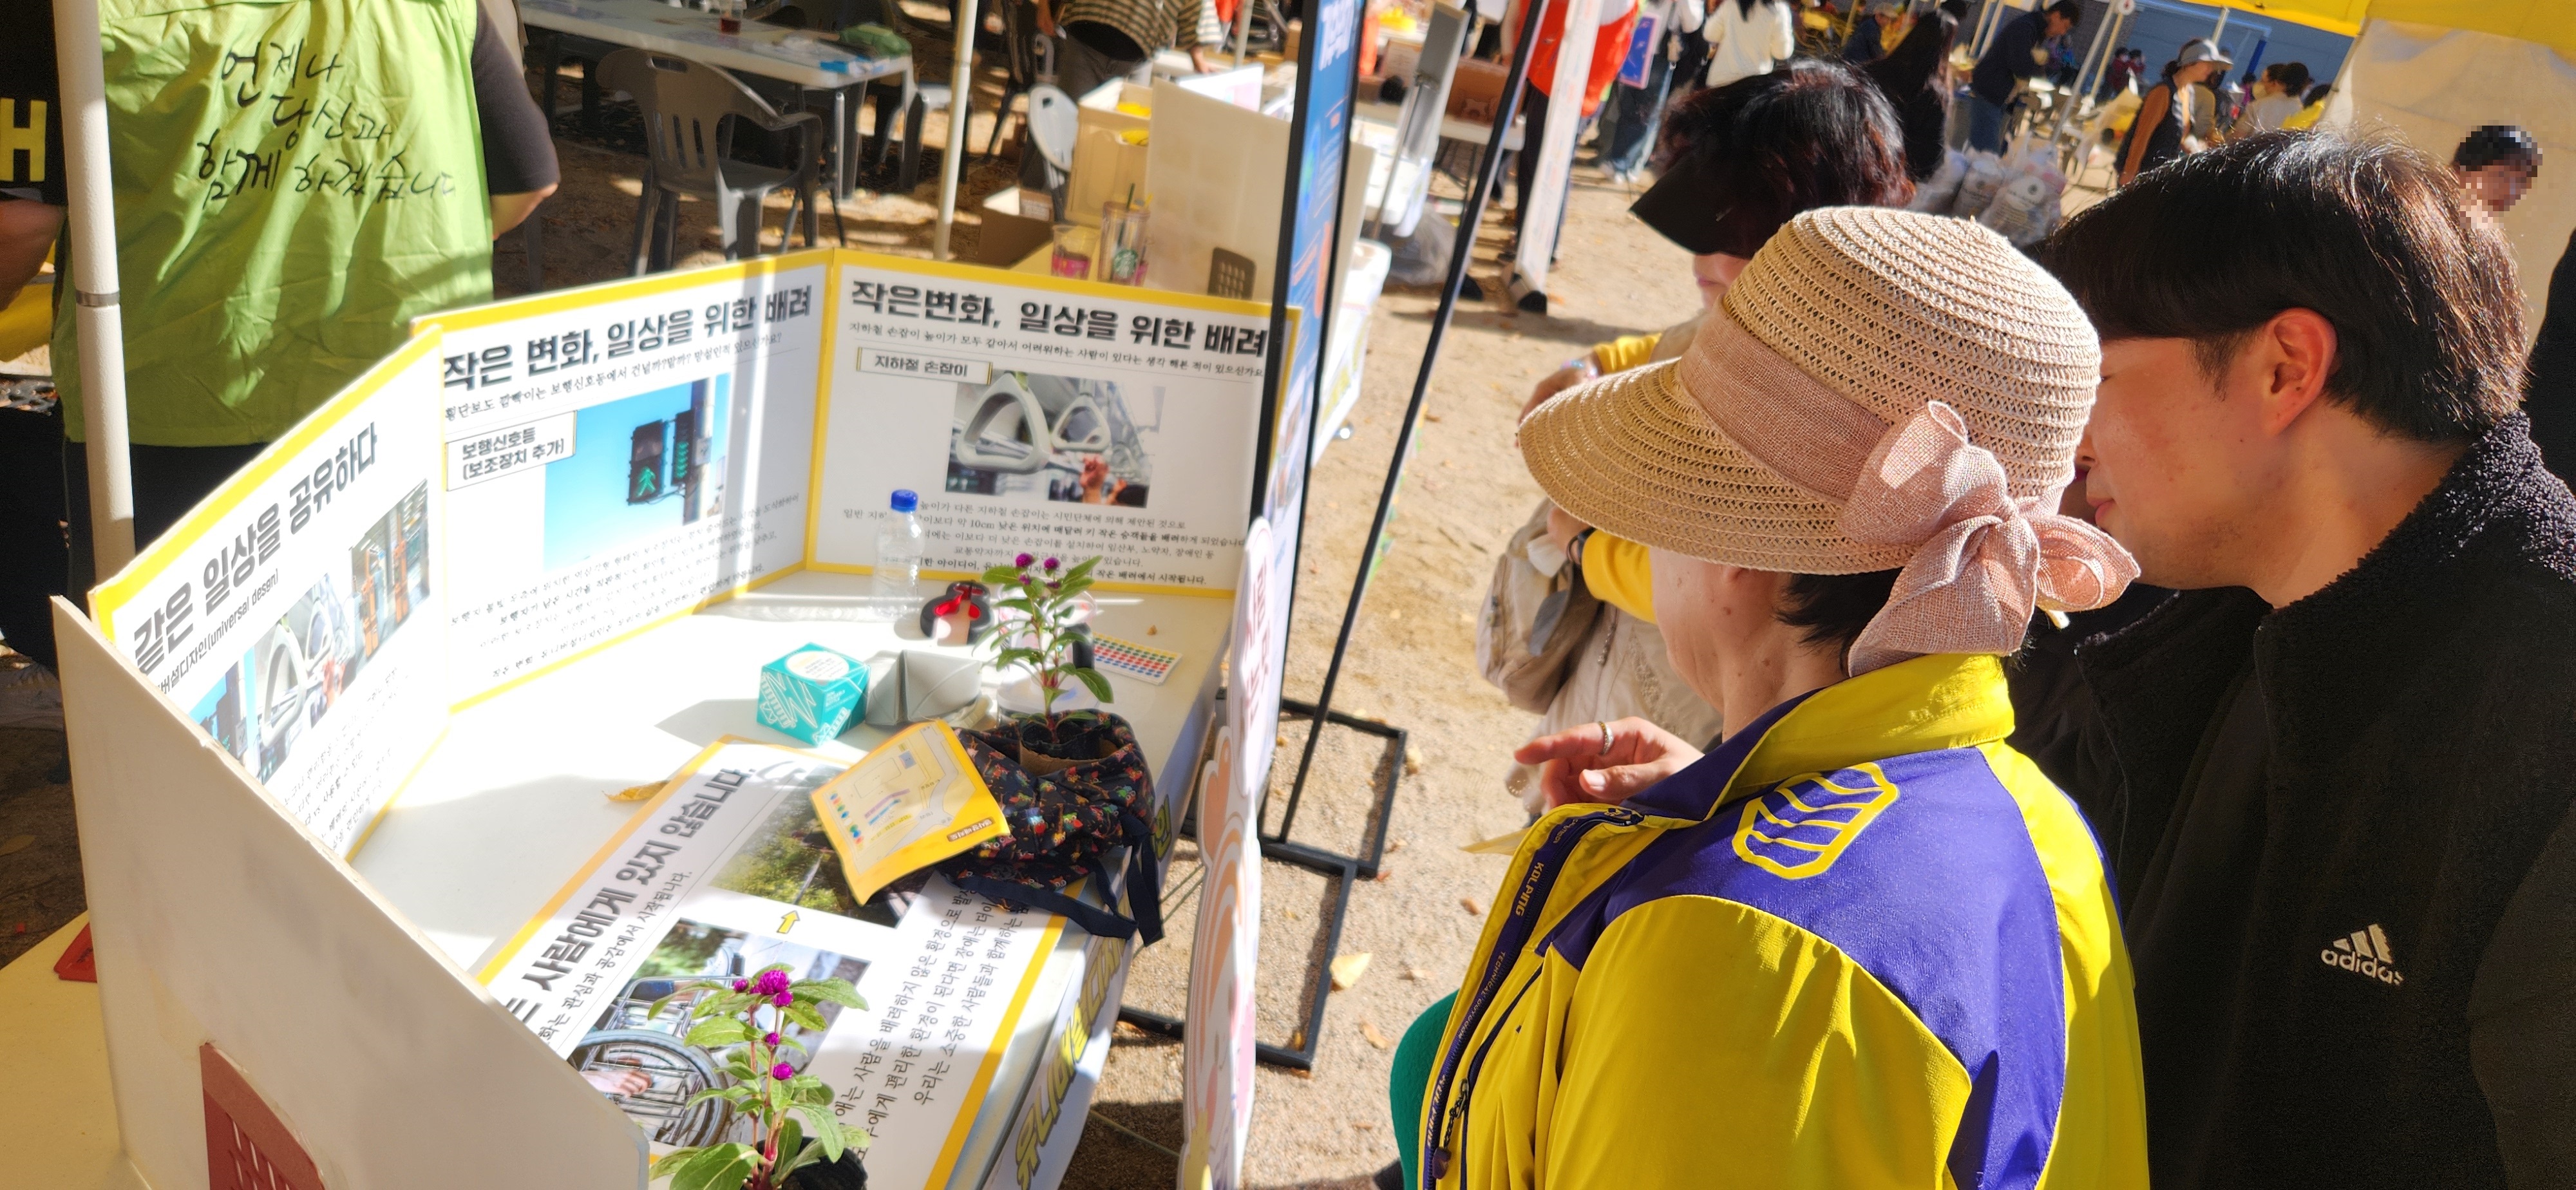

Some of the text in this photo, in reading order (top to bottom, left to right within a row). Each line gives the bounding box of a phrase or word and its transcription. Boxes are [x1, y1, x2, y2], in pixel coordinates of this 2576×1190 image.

[222, 39, 343, 108] 언제나
[270, 93, 392, 150] 당신과
[197, 129, 282, 209] 함께
[444, 285, 812, 391] 작은 변화, 일상을 위한 배려
[849, 323, 882, 335] 지하철
[887, 326, 920, 339] 손잡이
[924, 331, 957, 344] 높이가
[961, 335, 982, 346] 모두
[985, 339, 1018, 351] 같아서
[1022, 342, 1074, 357] 어려워하는
[1077, 346, 1108, 361] 사람이
[1113, 352, 1142, 364] 있다는
[1146, 356, 1165, 367] 생각
[1170, 359, 1189, 370] 해본
[1193, 361, 1211, 372] 적이
[851, 280, 1268, 357] 작은변화, 일상을 위한 배려
[445, 399, 495, 421] 횡단보도
[500, 387, 546, 408] 깜빡이는
[551, 366, 627, 395] 보행신호등에서
[875, 354, 968, 377] 지하철 손잡이
[462, 426, 535, 460] 보행신호등
[134, 421, 377, 676] 같은 일상을 공유하다
[970, 518, 994, 529] 10cm
[155, 596, 250, 695] 버설디자인(universal
[522, 768, 757, 992] 사람에게 있지 않습니다.
[1515, 862, 1544, 917] KOLPING
[562, 972, 603, 1010] 관심과
[595, 924, 644, 970] 공감에서
[637, 871, 693, 923] 시작됩니다.
[1481, 950, 1506, 996] TECHNICAL
[835, 1086, 864, 1117] 애는
[854, 1037, 891, 1082] 사람을
[880, 981, 922, 1033] 배려하지
[911, 955, 937, 978] 않은
[925, 909, 962, 952] 환경으로
[885, 1045, 922, 1088] 편리한
[909, 1001, 945, 1041] 환경이
[934, 961, 967, 997] 된다면
[955, 926, 987, 958] 장애는
[914, 917, 1023, 1105] 우리는 소중한 사람들과 함께하는
